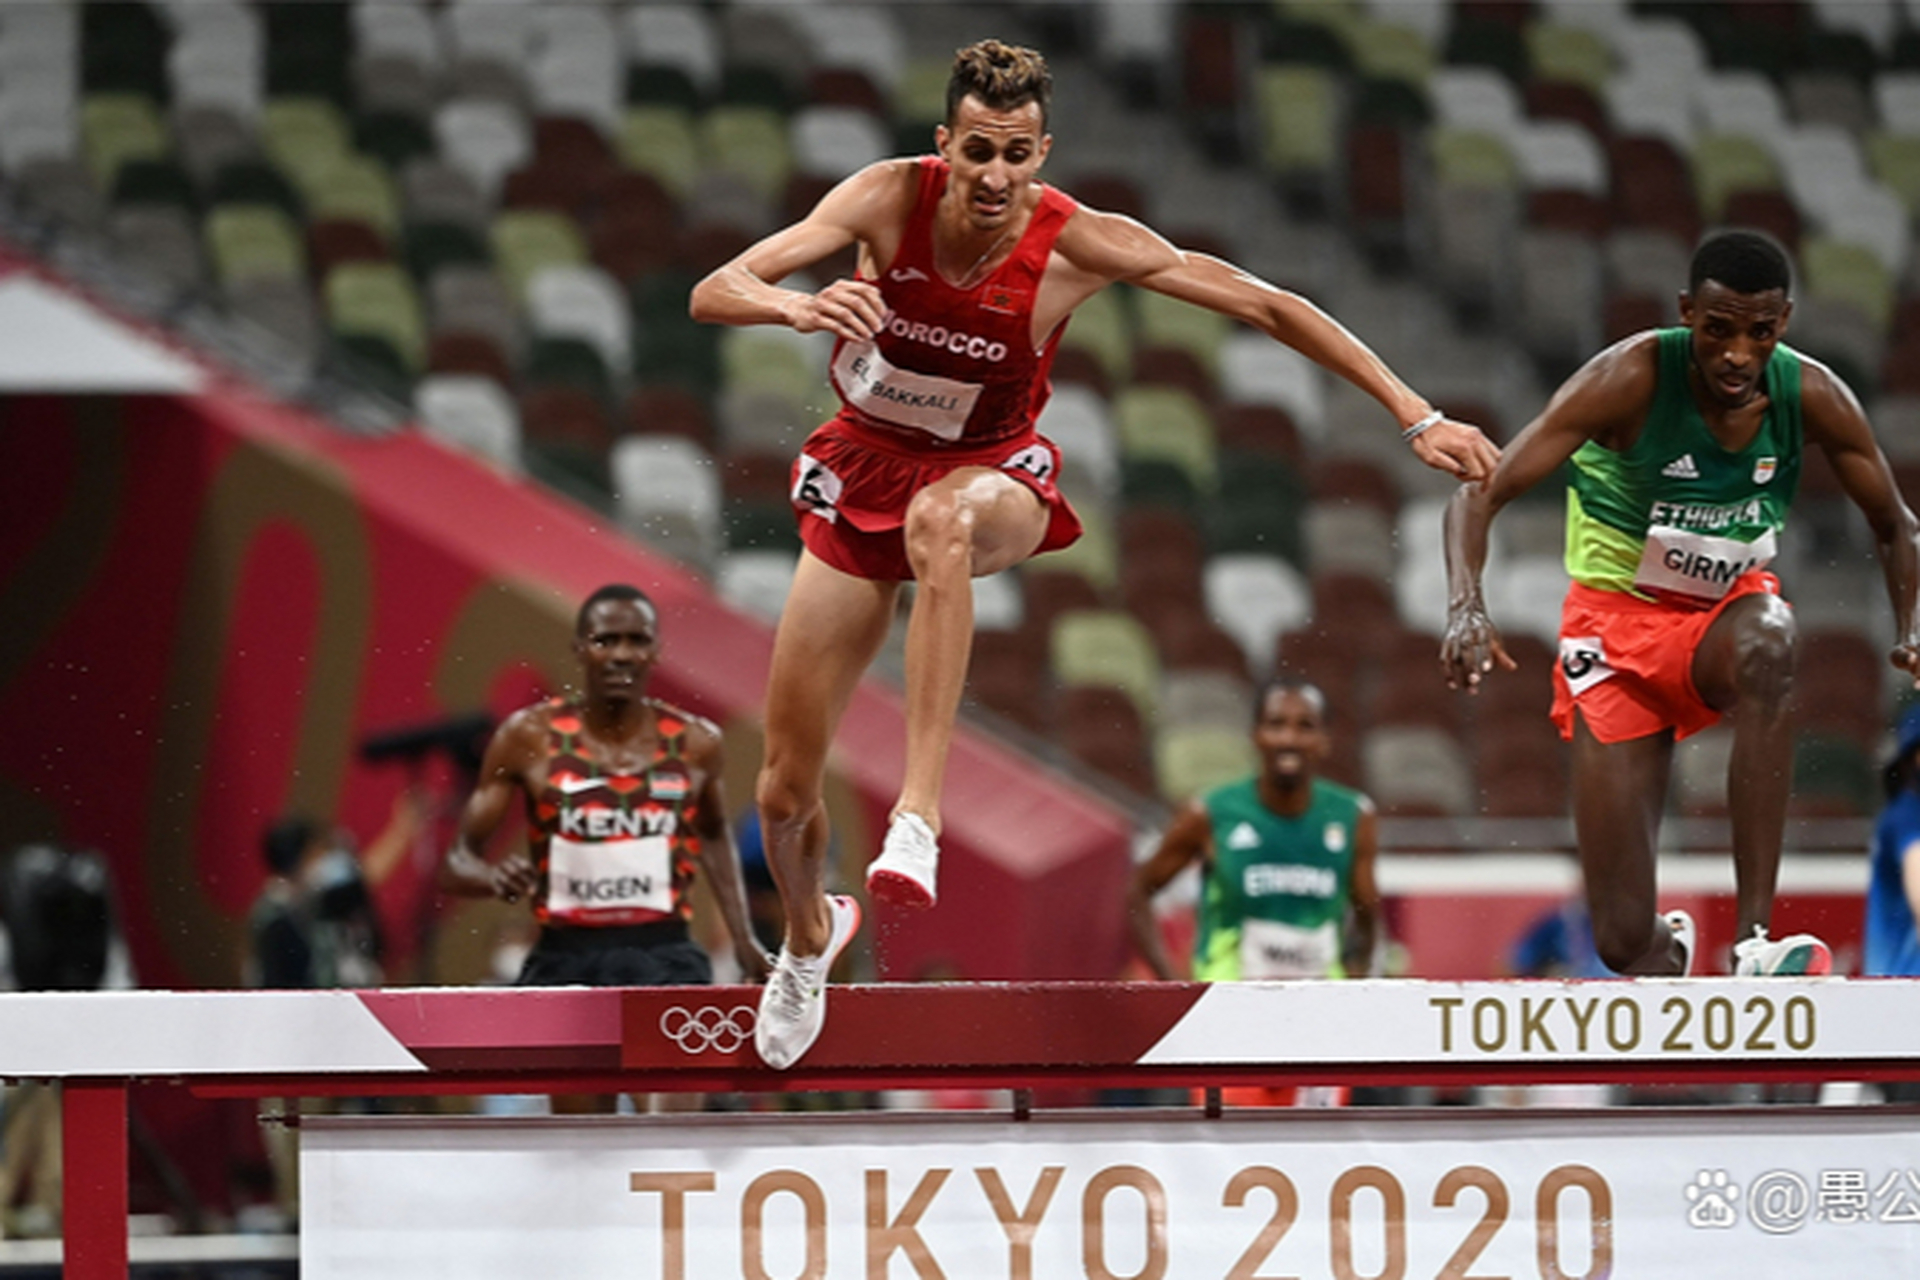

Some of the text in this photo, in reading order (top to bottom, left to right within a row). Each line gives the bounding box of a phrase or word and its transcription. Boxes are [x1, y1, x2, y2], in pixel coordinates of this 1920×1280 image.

[850, 356, 959, 410] EL BAKKALI
[1663, 548, 1756, 584] GIRM
[568, 876, 651, 900] KIGEN
[1430, 996, 1817, 1052] TOKYO 2020
[629, 1164, 1614, 1280] TOKYO 2020
